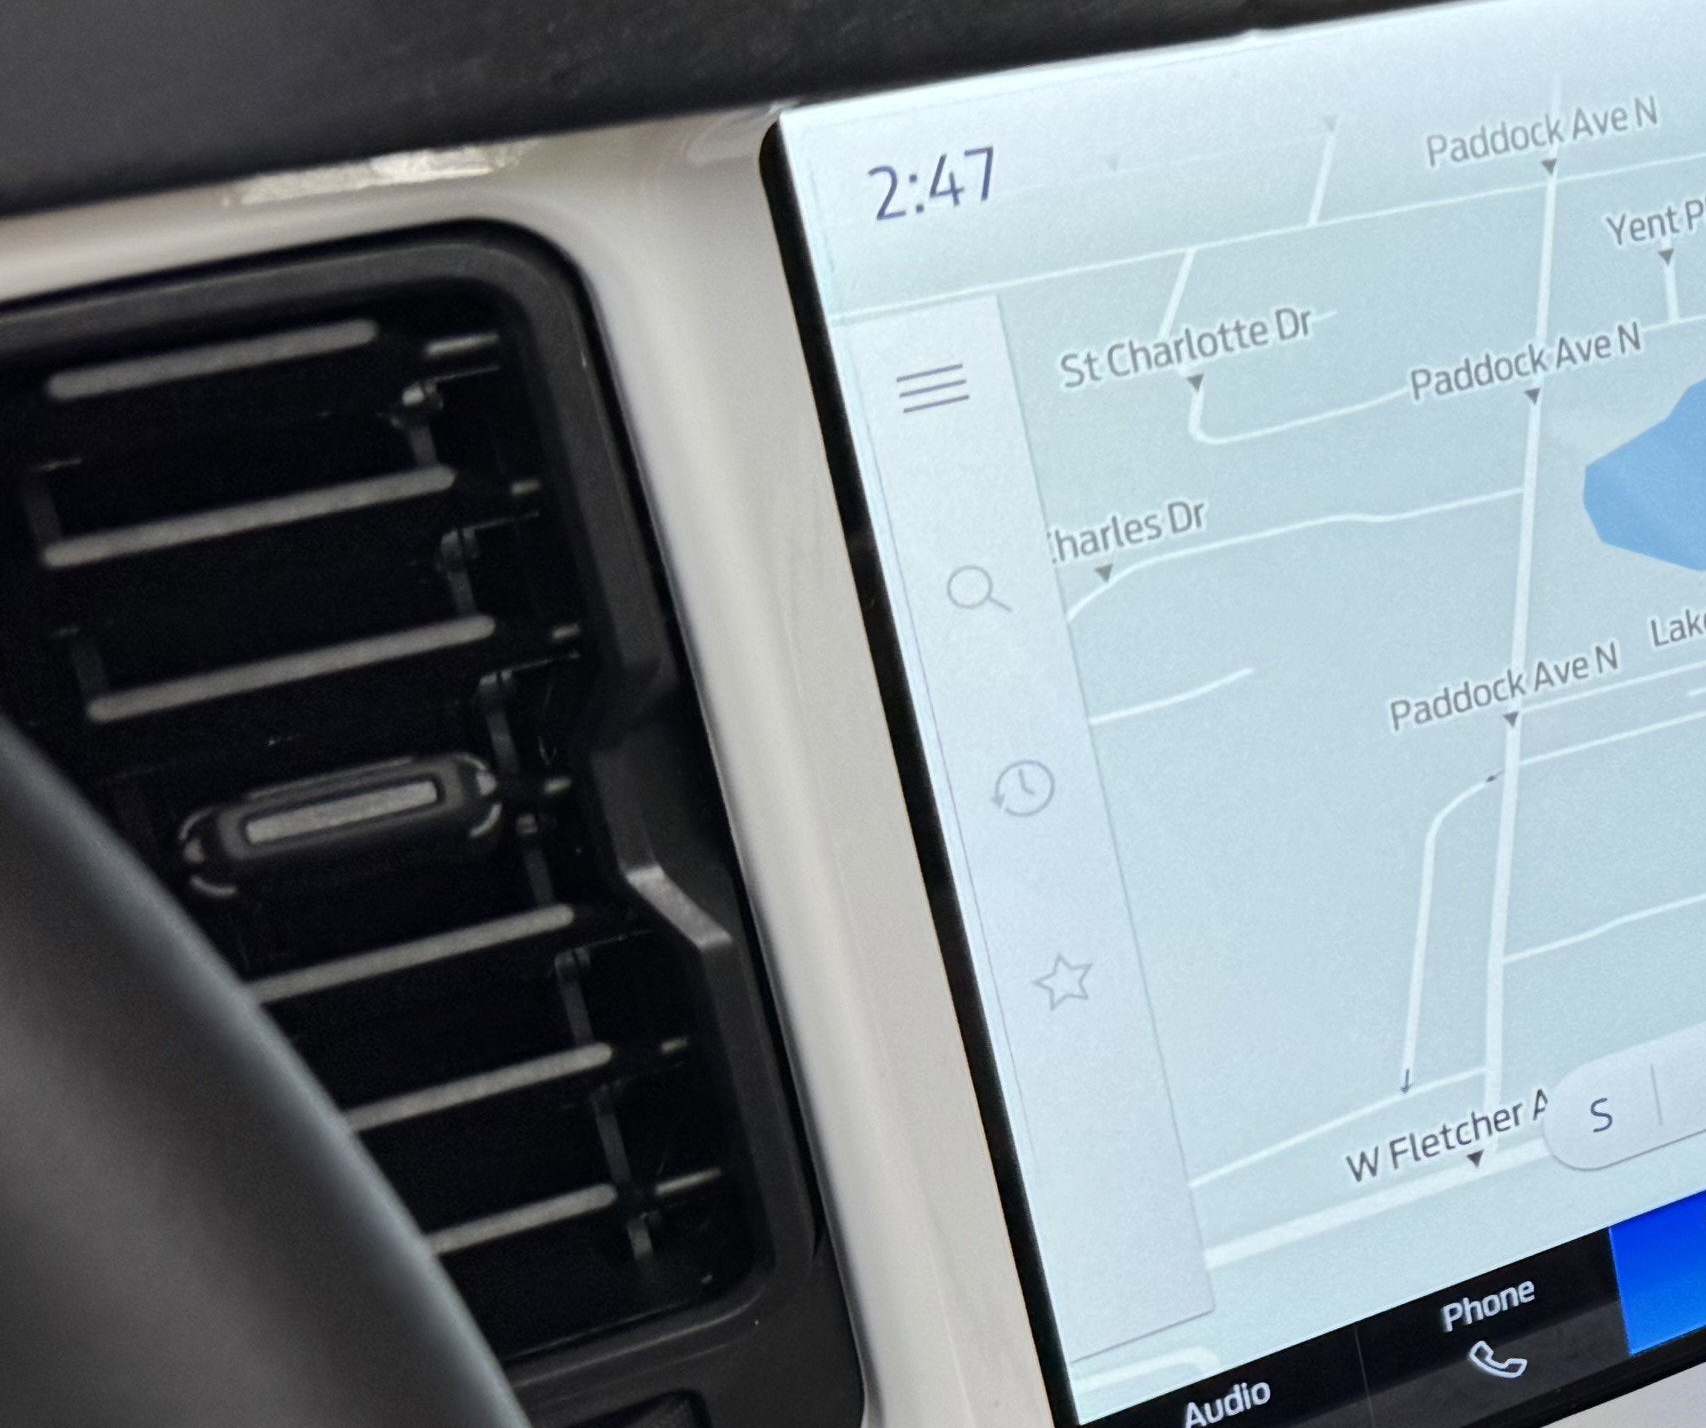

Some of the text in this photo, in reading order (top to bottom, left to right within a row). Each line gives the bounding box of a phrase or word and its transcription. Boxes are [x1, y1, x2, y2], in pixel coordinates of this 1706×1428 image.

[1426, 98, 1658, 167] Paddock Ave N
[868, 146, 996, 222] 2:47
[1606, 209, 1681, 247] Yent
[1061, 306, 1314, 388] St Charlotte Dr
[1410, 323, 1642, 400] Paddock Ave N
[1047, 500, 1204, 564] harles Dr
[1390, 642, 1620, 732] Paddock Ave N
[1346, 1146, 1379, 1183] W
[1389, 1103, 1523, 1170] Fletcher
[1590, 1098, 1614, 1133] S
[1441, 1277, 1535, 1332] Phone
